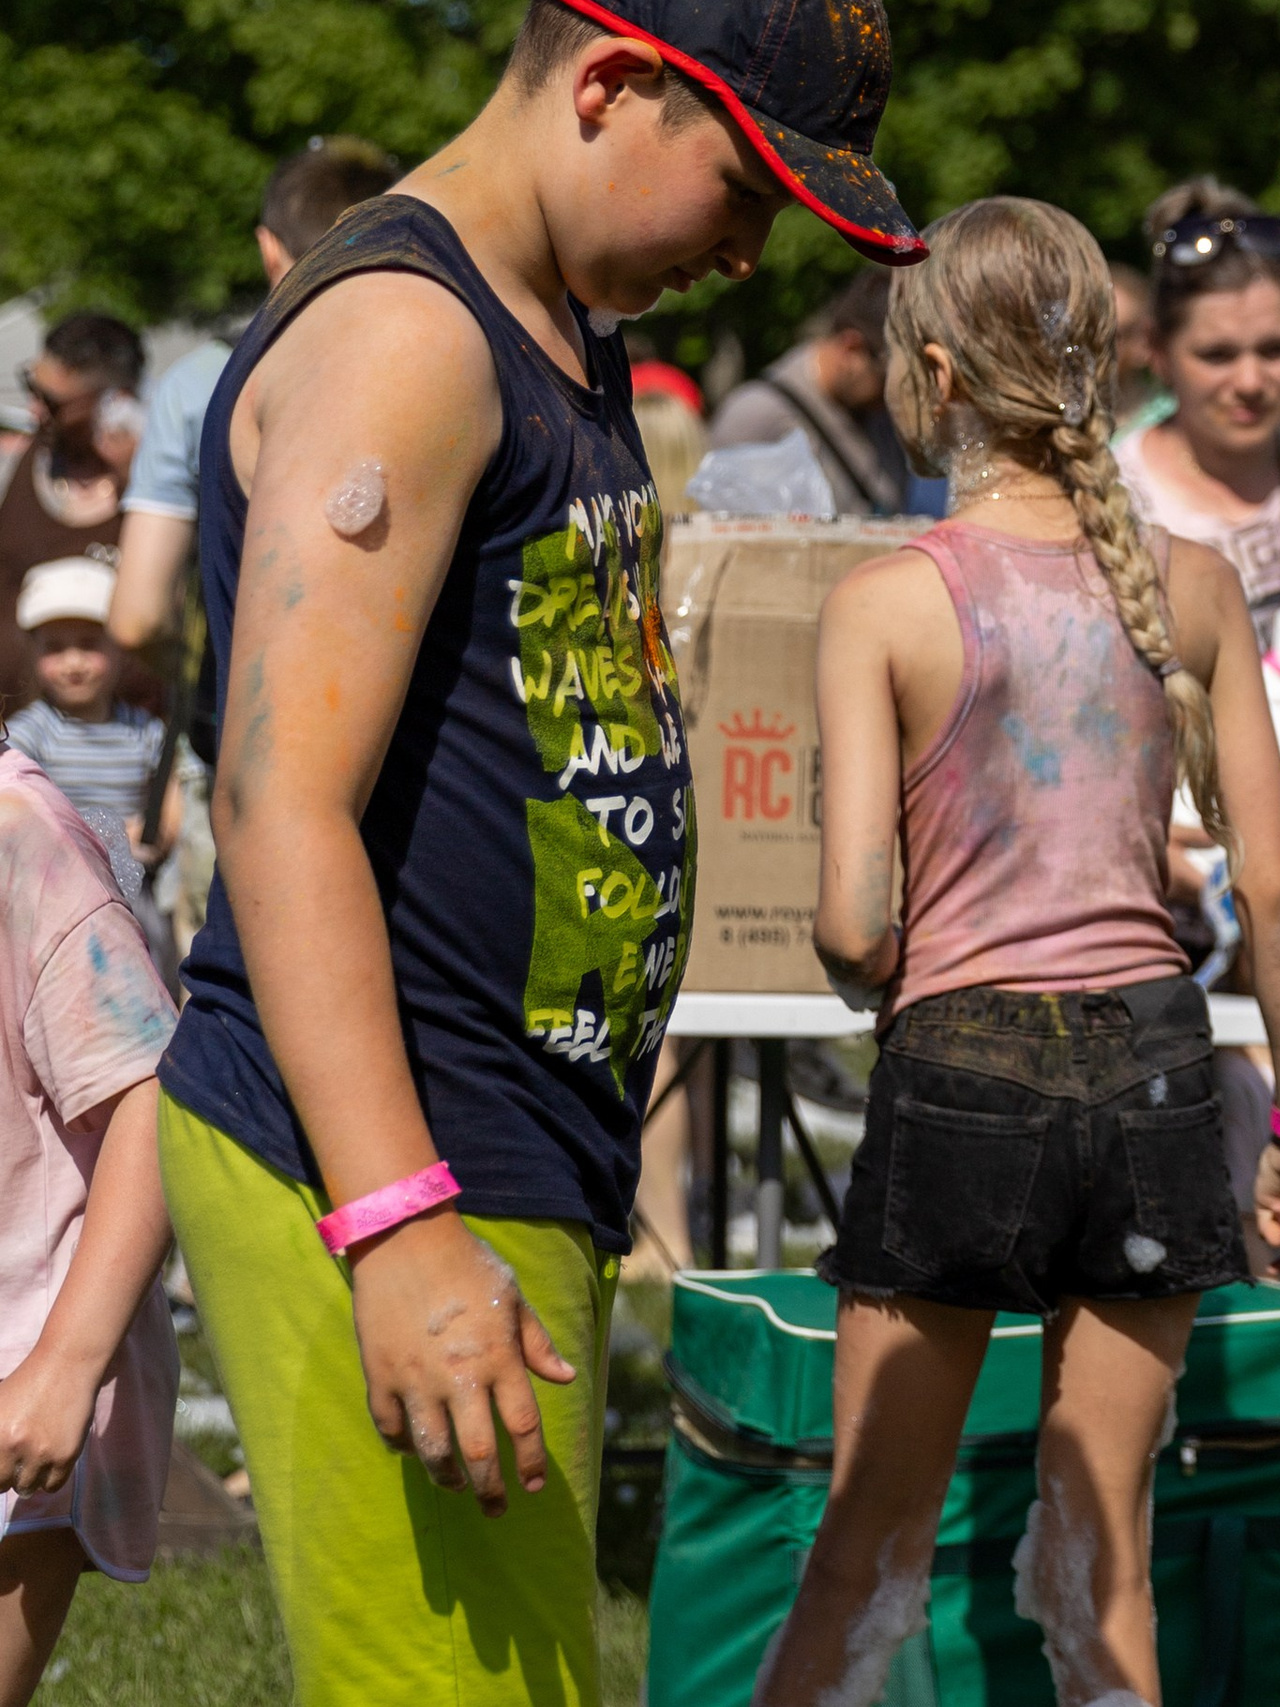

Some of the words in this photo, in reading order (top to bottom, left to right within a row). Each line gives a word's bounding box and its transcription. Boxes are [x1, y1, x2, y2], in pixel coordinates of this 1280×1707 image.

[510, 648, 642, 718] WAVES
[558, 722, 646, 791] AND
[722, 745, 793, 822] RC
[585, 794, 655, 848] TO
[525, 1007, 612, 1063] FEEL
